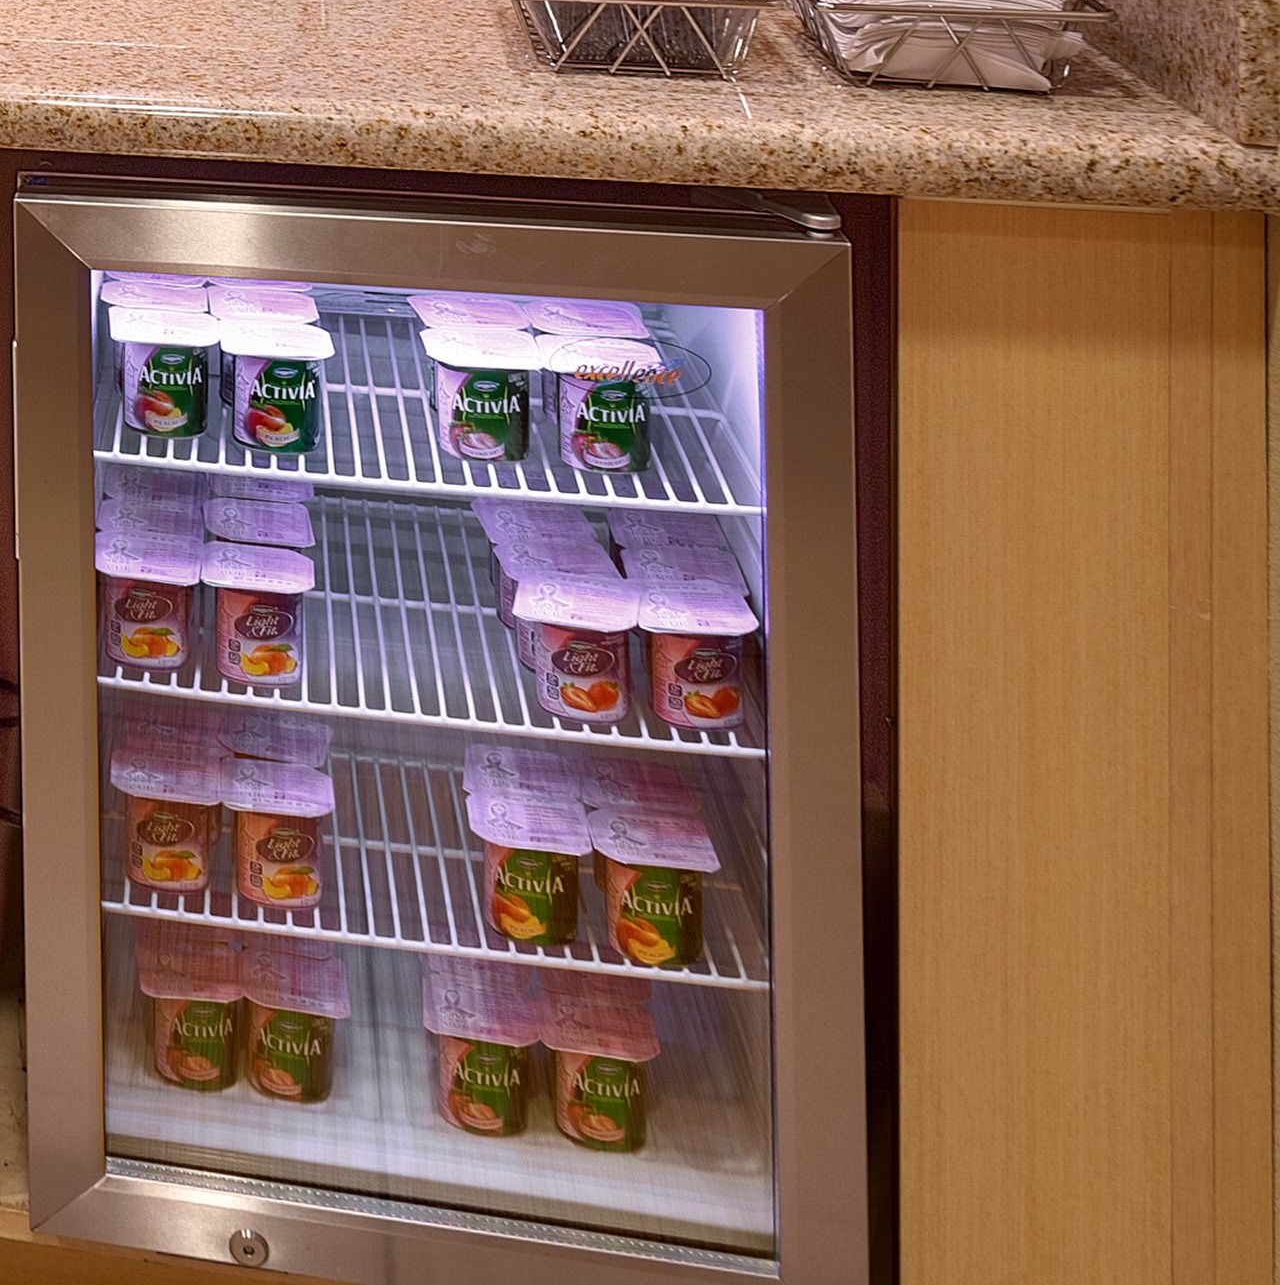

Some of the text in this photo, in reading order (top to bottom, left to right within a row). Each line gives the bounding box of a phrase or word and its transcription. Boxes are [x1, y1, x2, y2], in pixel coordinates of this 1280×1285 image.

[139, 364, 203, 386] ACTIVIA
[574, 360, 682, 386] excellence
[250, 379, 316, 400] ACTIVIA
[451, 393, 521, 414] ACTIVIA
[576, 402, 647, 424] ACTIVIA
[125, 598, 158, 612] Light
[246, 615, 280, 629] Light
[563, 651, 599, 664] Light
[495, 866, 565, 894] ACTIVIA
[621, 890, 693, 916] ACTIVIA
[171, 1016, 233, 1038] ACTIVIA
[258, 1026, 322, 1056] ACTIVIA
[453, 1062, 521, 1087] ACTIVIA
[573, 1072, 641, 1097] ACTIVIA
